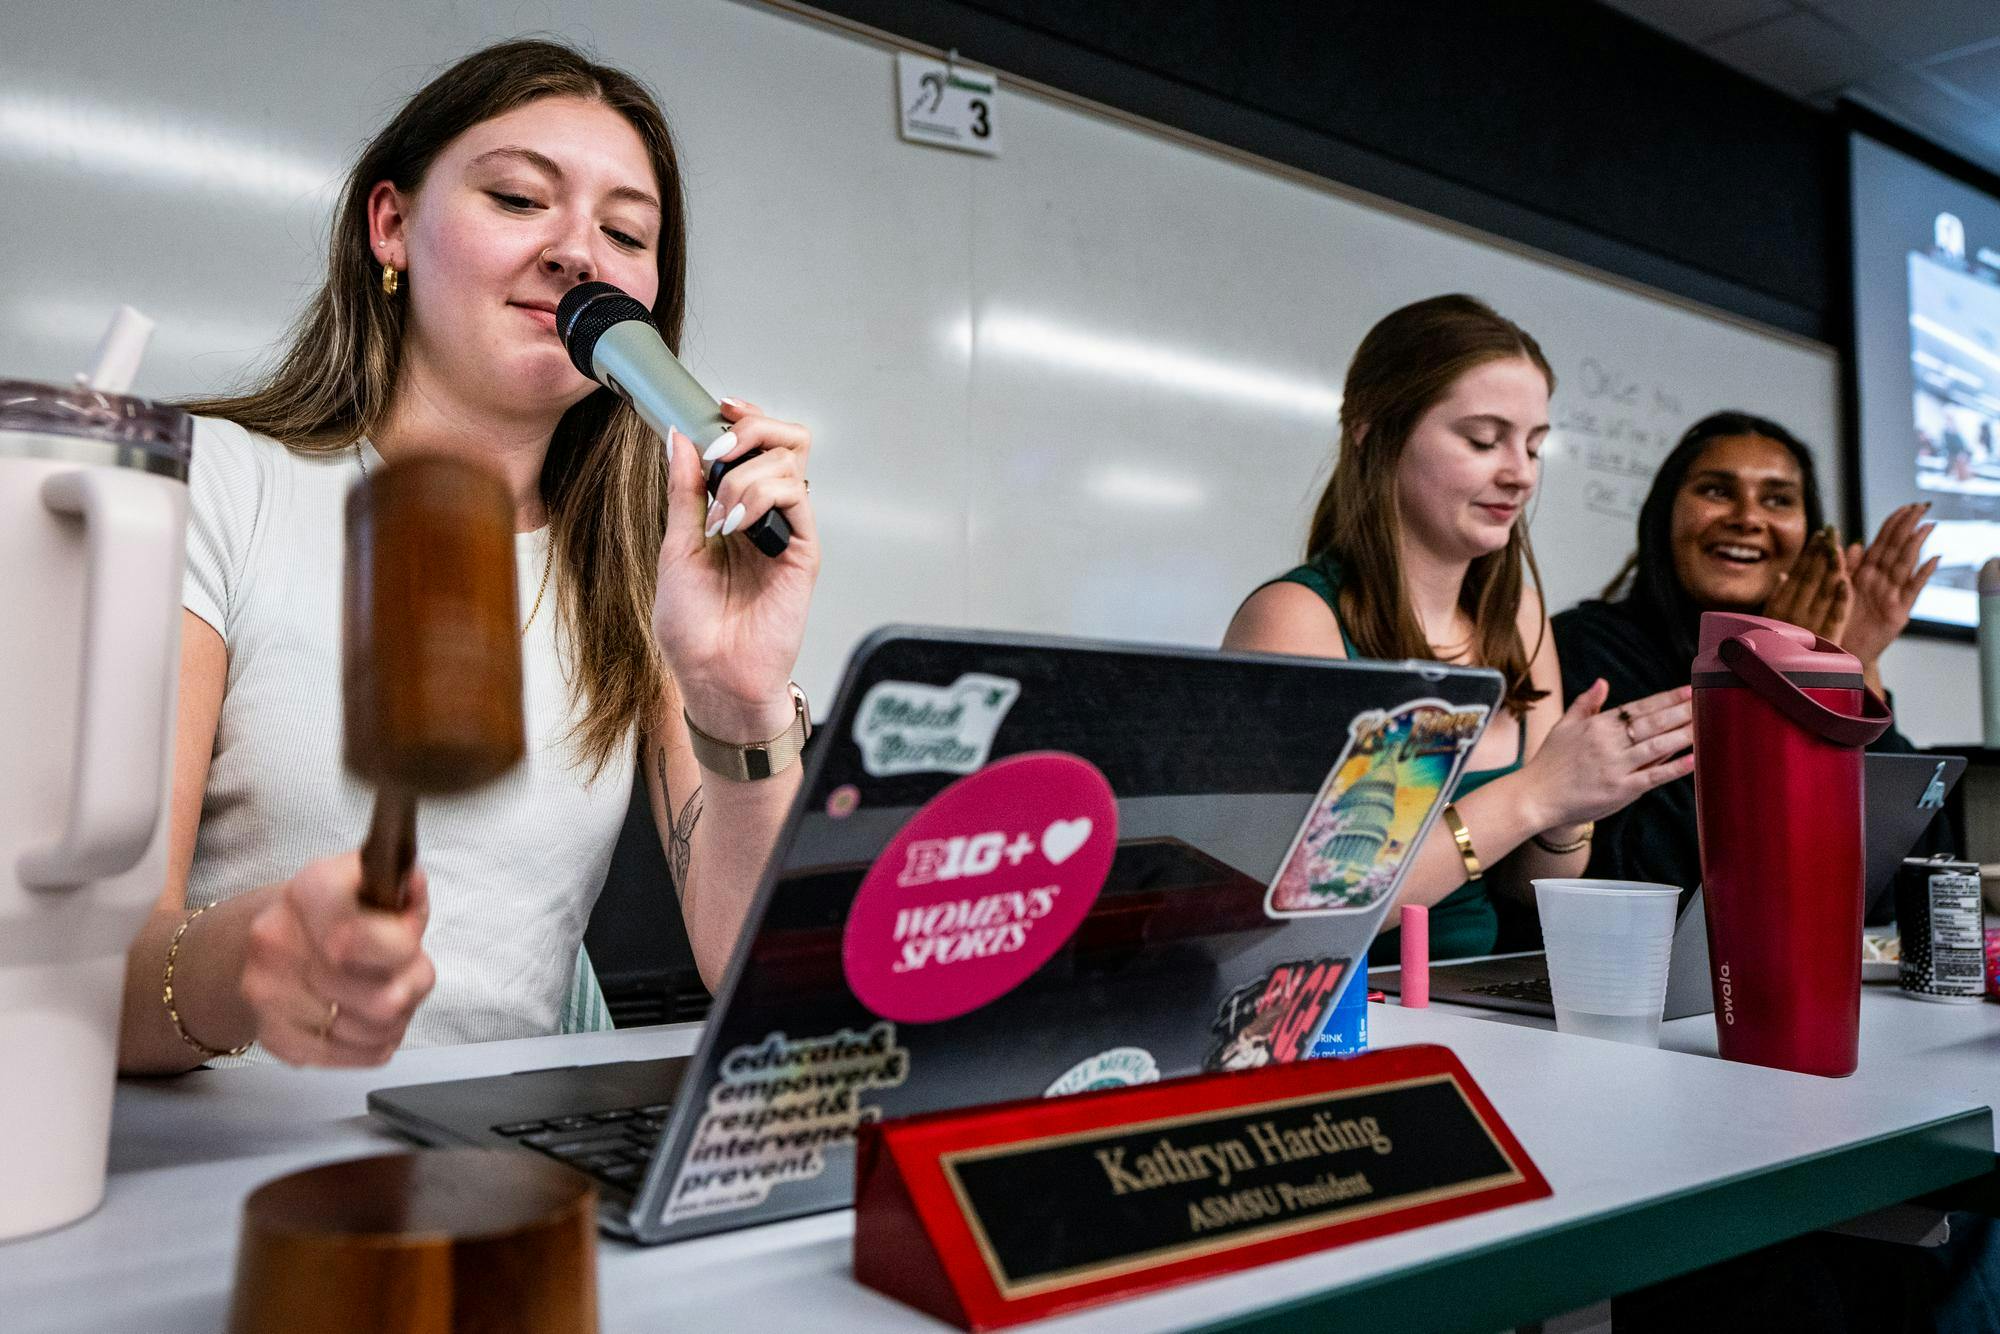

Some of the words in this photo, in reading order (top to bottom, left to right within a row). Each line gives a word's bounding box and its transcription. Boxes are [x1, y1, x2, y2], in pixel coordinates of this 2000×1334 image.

[968, 99, 990, 138] 3
[892, 918, 1033, 973] SPORTS
[1720, 965, 1735, 1026] owala
[1320, 1033, 1344, 1043] RINK
[1095, 1138, 1256, 1195] Kathryn
[1246, 1111, 1393, 1166] Harding
[1187, 1182, 1281, 1232] ASMSU
[1275, 1170, 1375, 1211] President
